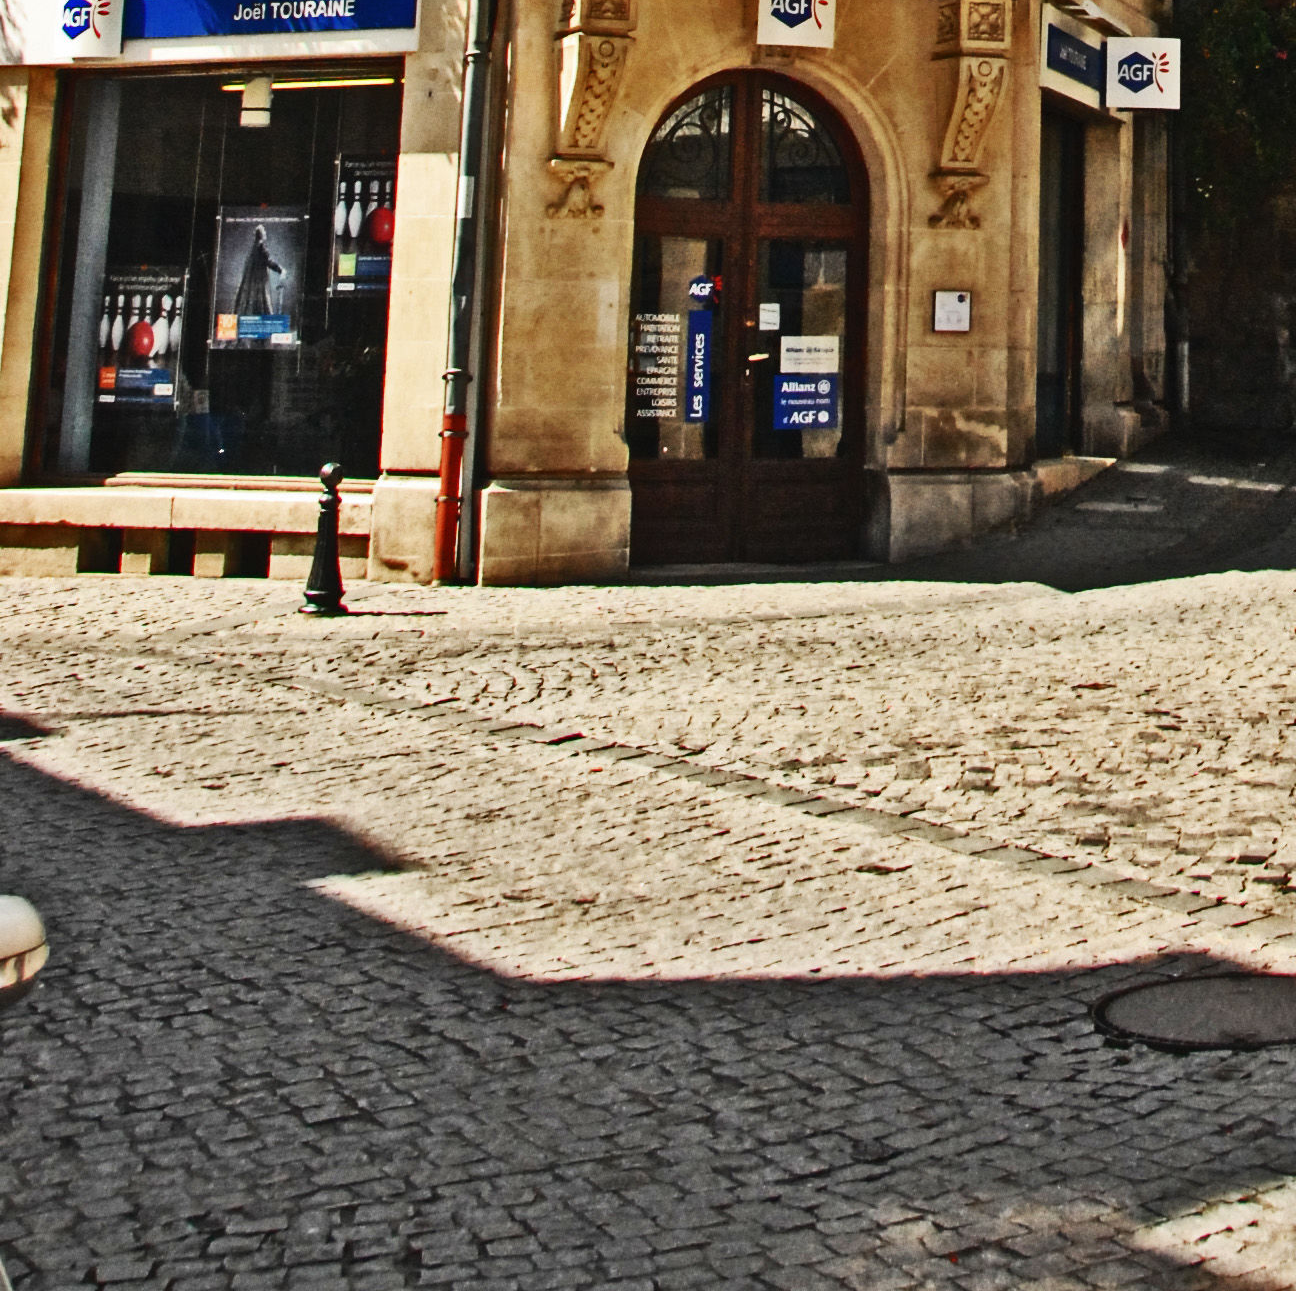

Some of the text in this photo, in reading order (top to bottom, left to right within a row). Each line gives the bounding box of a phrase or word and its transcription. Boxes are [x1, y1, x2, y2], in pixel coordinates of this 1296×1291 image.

[61, 4, 91, 28] AGF
[233, 1, 265, 21] Joël
[1118, 63, 1154, 82] AGF
[688, 282, 713, 296] AGF
[635, 313, 680, 323] AUTOMOBILE
[636, 376, 678, 386] COMMERCE
[690, 333, 705, 418] Les services
[636, 387, 677, 397] ENTREPRISE
[781, 381, 816, 393] Allianz
